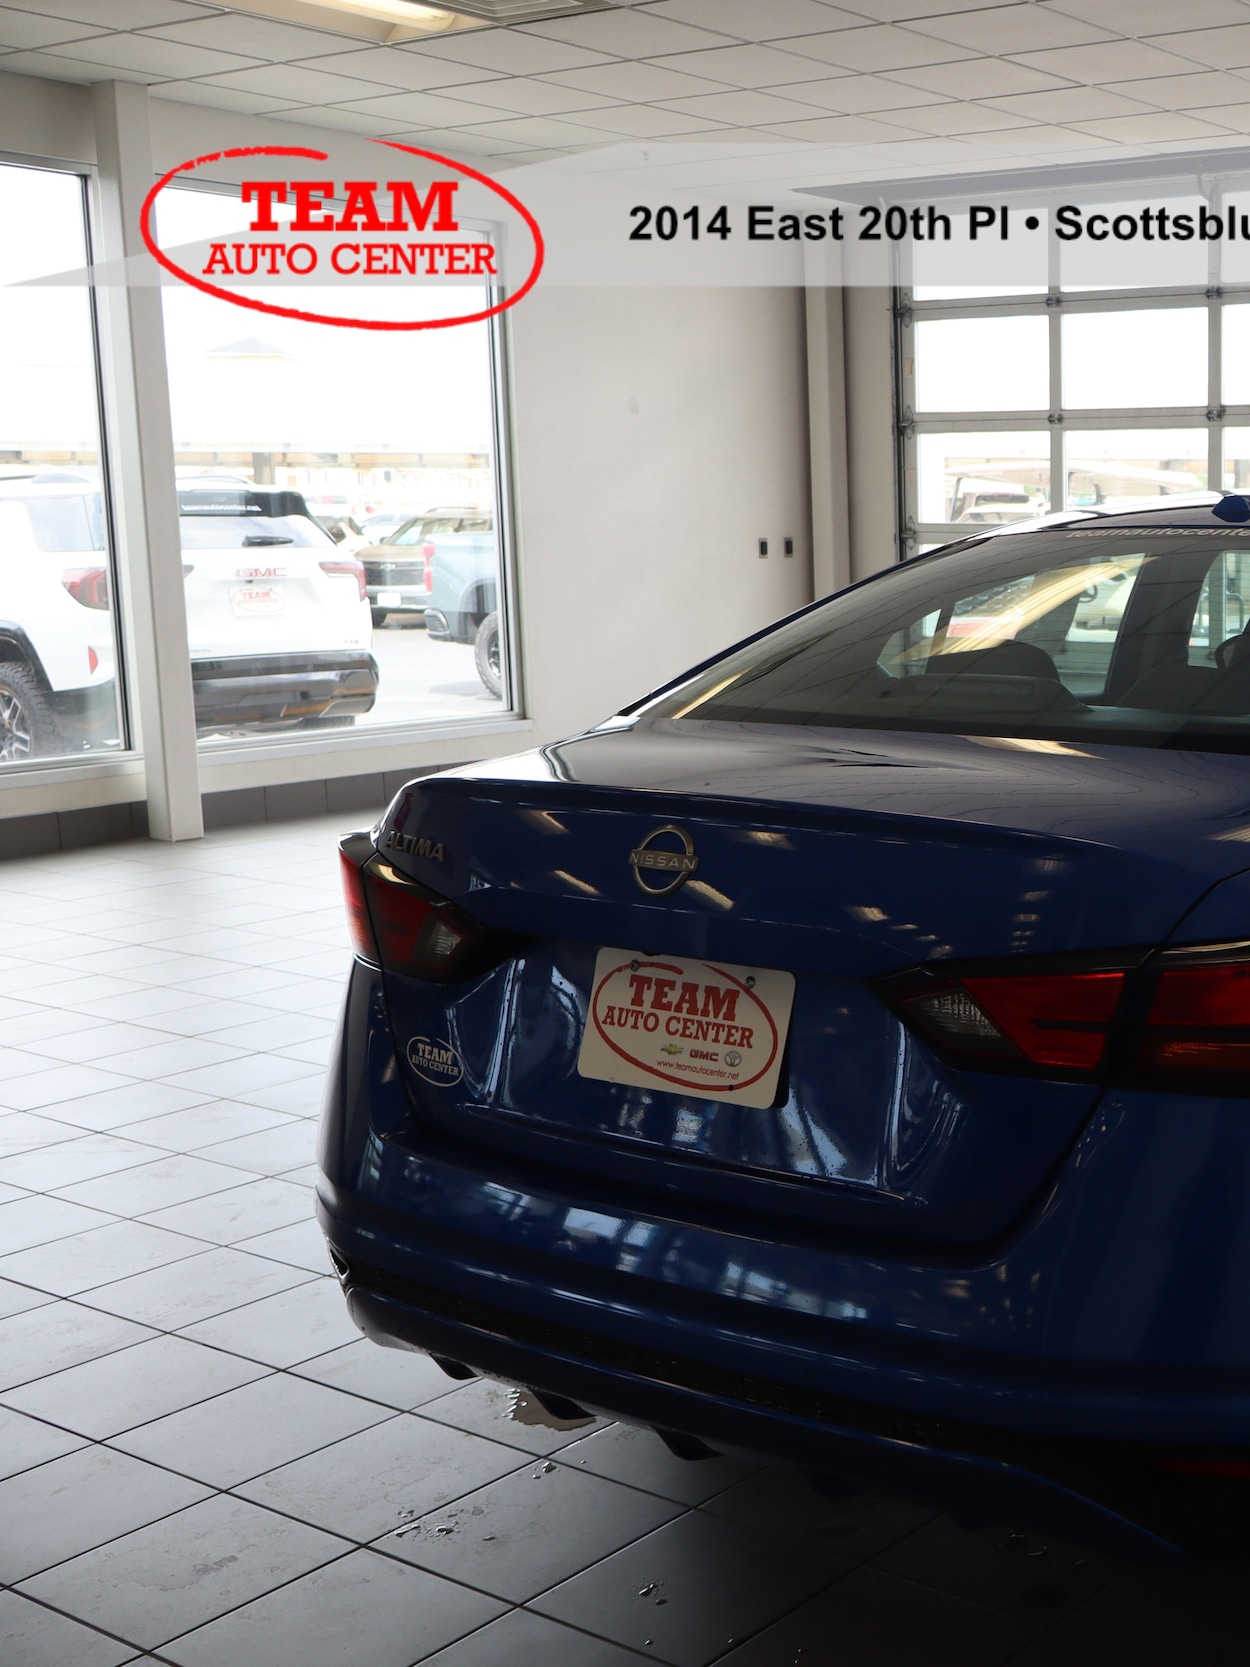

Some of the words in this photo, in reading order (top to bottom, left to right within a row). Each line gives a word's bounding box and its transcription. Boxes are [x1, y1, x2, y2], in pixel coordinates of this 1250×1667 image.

[235, 567, 287, 578] GMC
[241, 591, 271, 599] TEAM
[385, 830, 445, 862] ALTIMA
[630, 851, 696, 870] NISSAN
[629, 973, 741, 1021] TEAM
[601, 1005, 660, 1033] AUTO
[665, 1015, 754, 1049] CENTER
[417, 1042, 454, 1065] TEAM
[689, 1048, 719, 1062] GMC
[412, 1054, 428, 1067] AUTO
[428, 1061, 459, 1076] CENTER
[656, 1059, 740, 1080] www.teamautocenter.net
